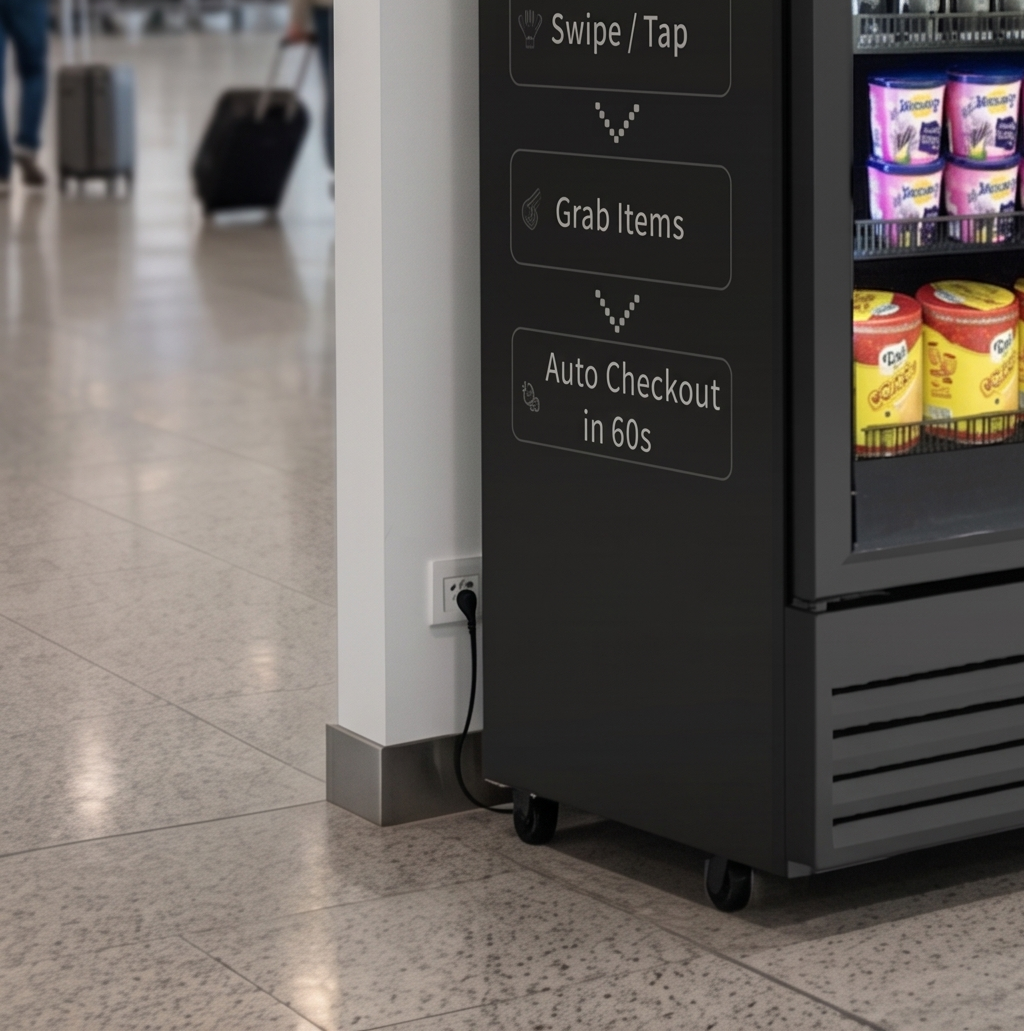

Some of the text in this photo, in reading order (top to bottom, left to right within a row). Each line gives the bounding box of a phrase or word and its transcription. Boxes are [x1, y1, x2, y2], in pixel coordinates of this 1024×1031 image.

[551, 11, 688, 58] Swipe / Tap
[555, 196, 685, 241] Grab Items
[545, 352, 721, 411] Auto Checkout
[583, 409, 652, 453] in 60s
